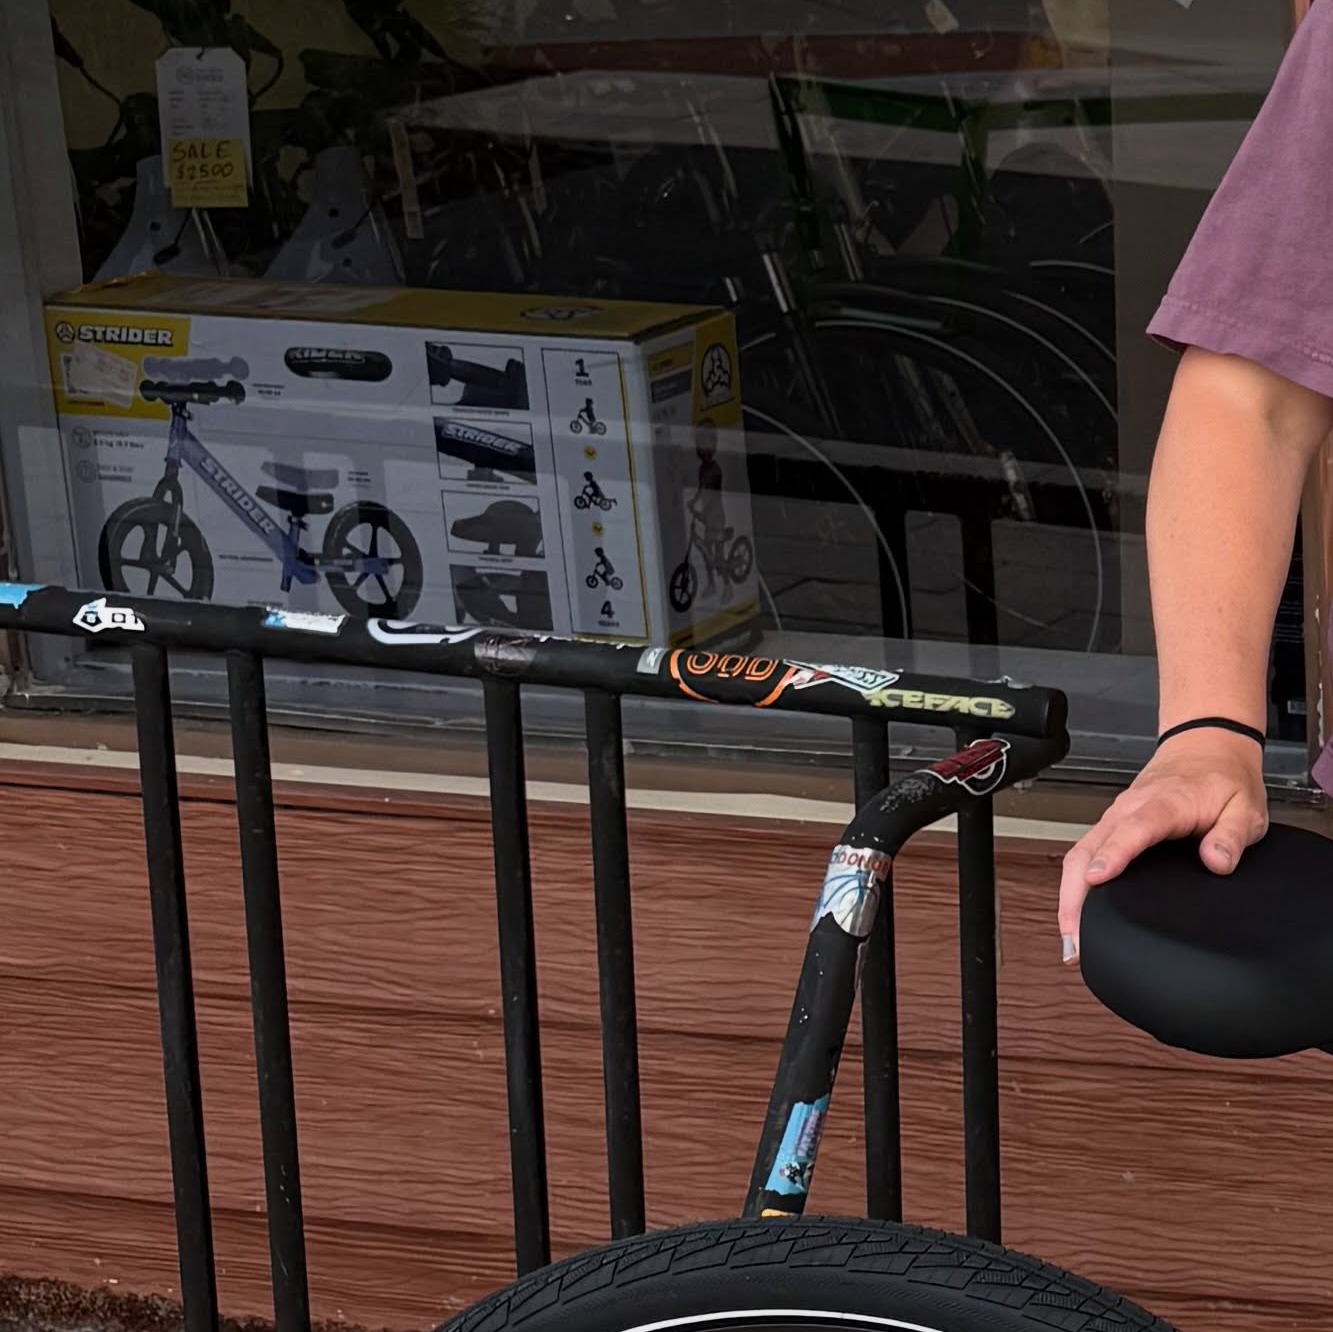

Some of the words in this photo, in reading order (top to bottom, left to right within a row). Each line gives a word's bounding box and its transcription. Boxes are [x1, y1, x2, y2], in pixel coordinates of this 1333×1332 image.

[172, 140, 231, 163] SALE
[78, 324, 173, 347] STRIDER
[574, 359, 590, 378] 1
[441, 423, 524, 456] STRIDER
[199, 457, 276, 535] STRIDER
[600, 600, 615, 619] 4
